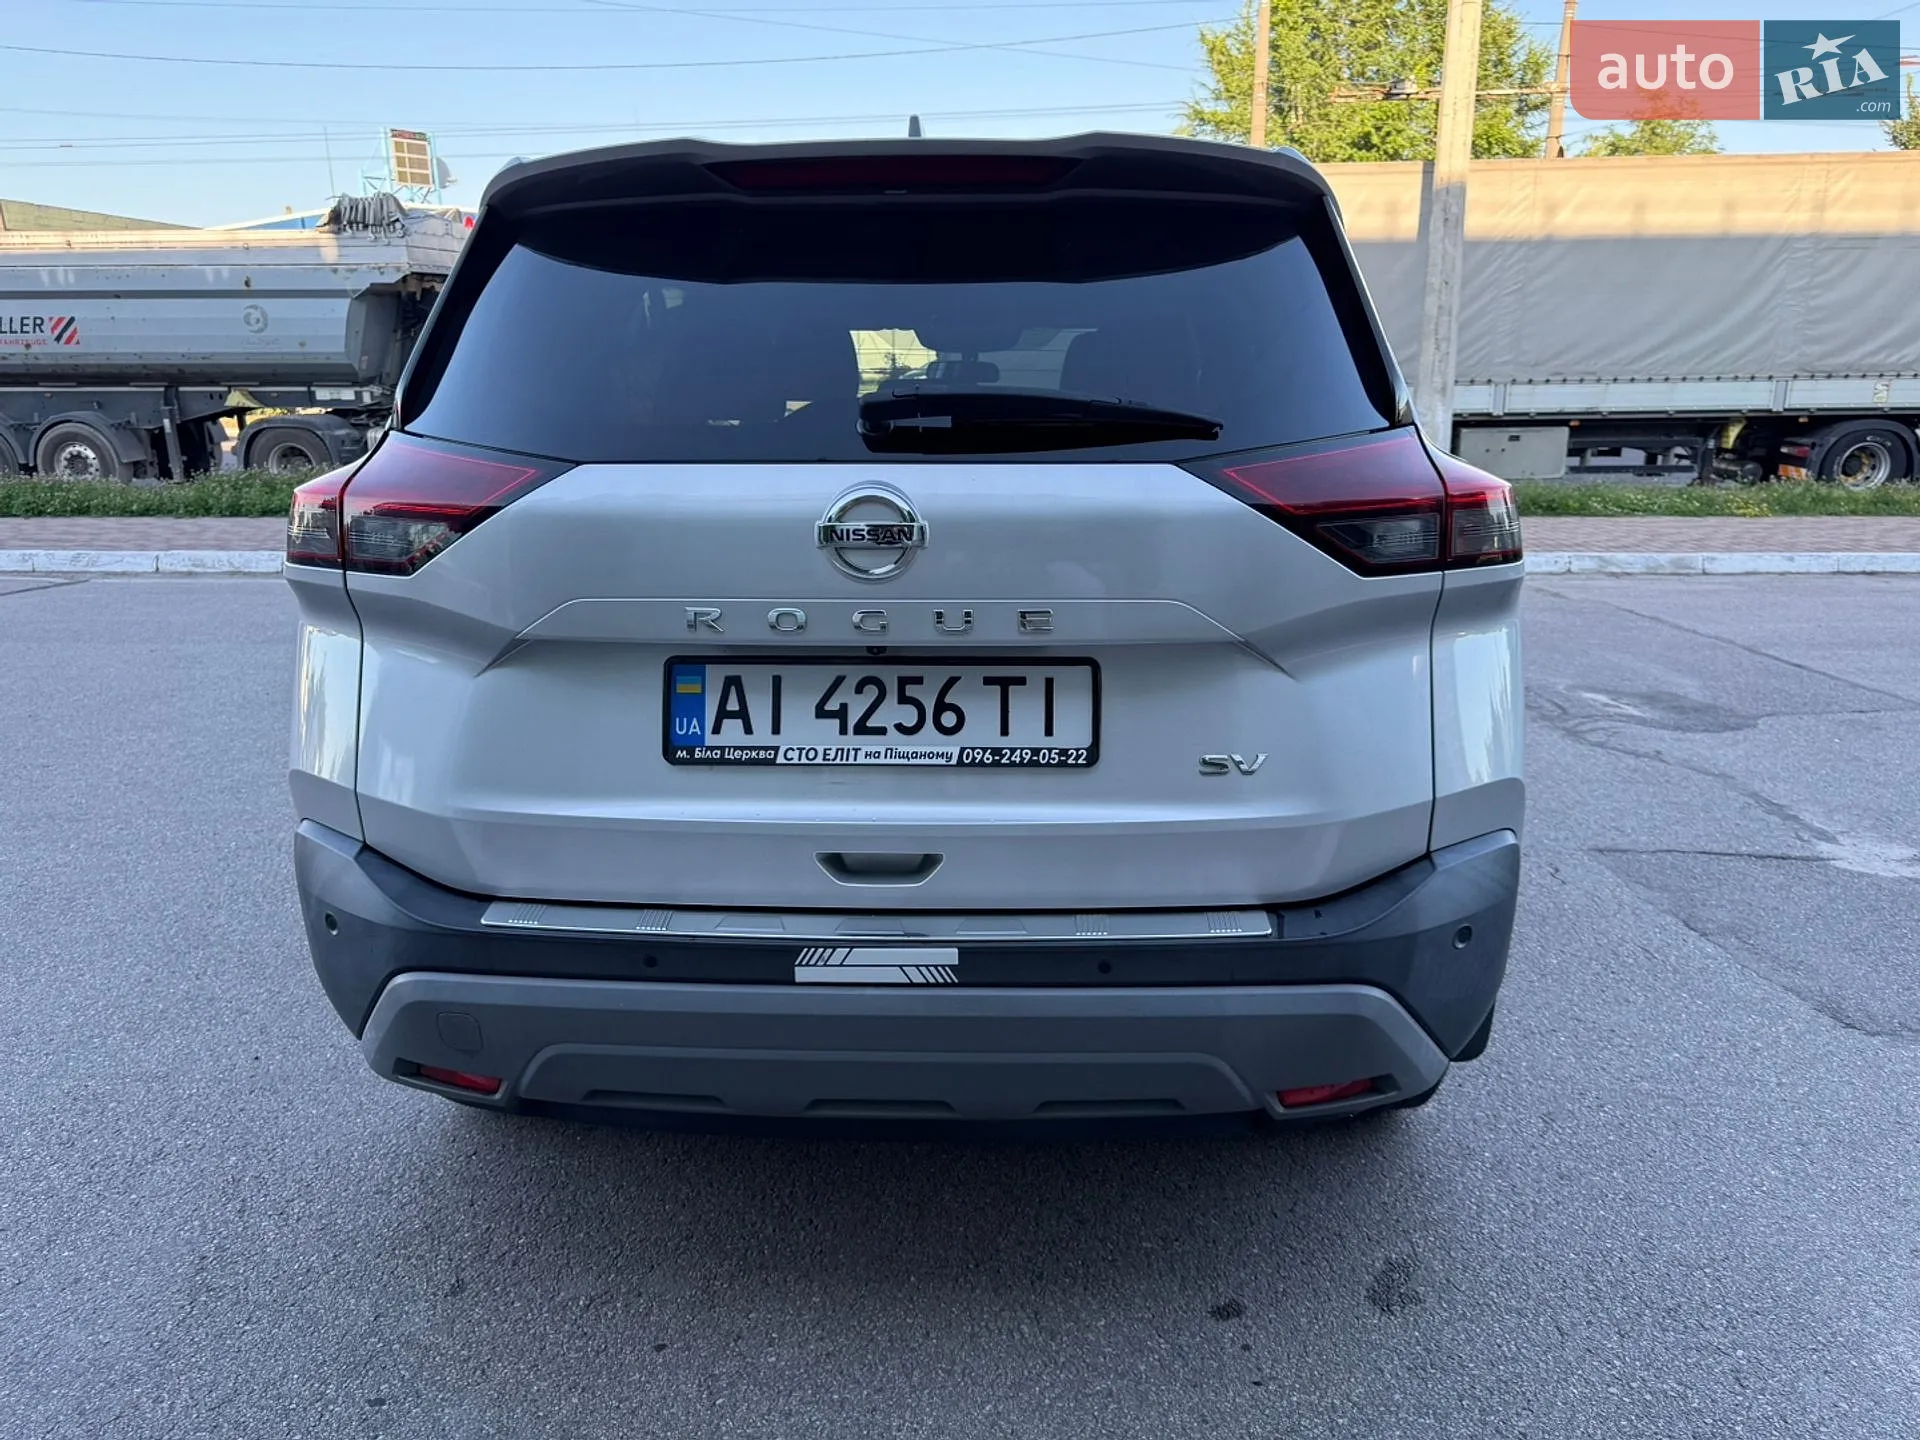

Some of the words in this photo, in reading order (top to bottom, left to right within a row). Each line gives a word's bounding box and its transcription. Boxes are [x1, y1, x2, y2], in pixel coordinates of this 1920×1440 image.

[830, 528, 912, 541] NISSAN
[685, 607, 1055, 633] ROGUE
[711, 675, 782, 735] AI
[815, 675, 966, 736] 4256
[983, 676, 1055, 736] TI
[675, 717, 701, 735] UA
[676, 750, 690, 759] м.
[694, 748, 720, 759] Біла
[724, 748, 775, 760] Церква
[783, 747, 818, 762] СТО
[822, 747, 861, 762] ЕЛІТ
[864, 751, 881, 760] на
[884, 748, 953, 763] Піщаному
[963, 749, 1087, 764] 096-249-05-22
[1199, 753, 1269, 777] SV
